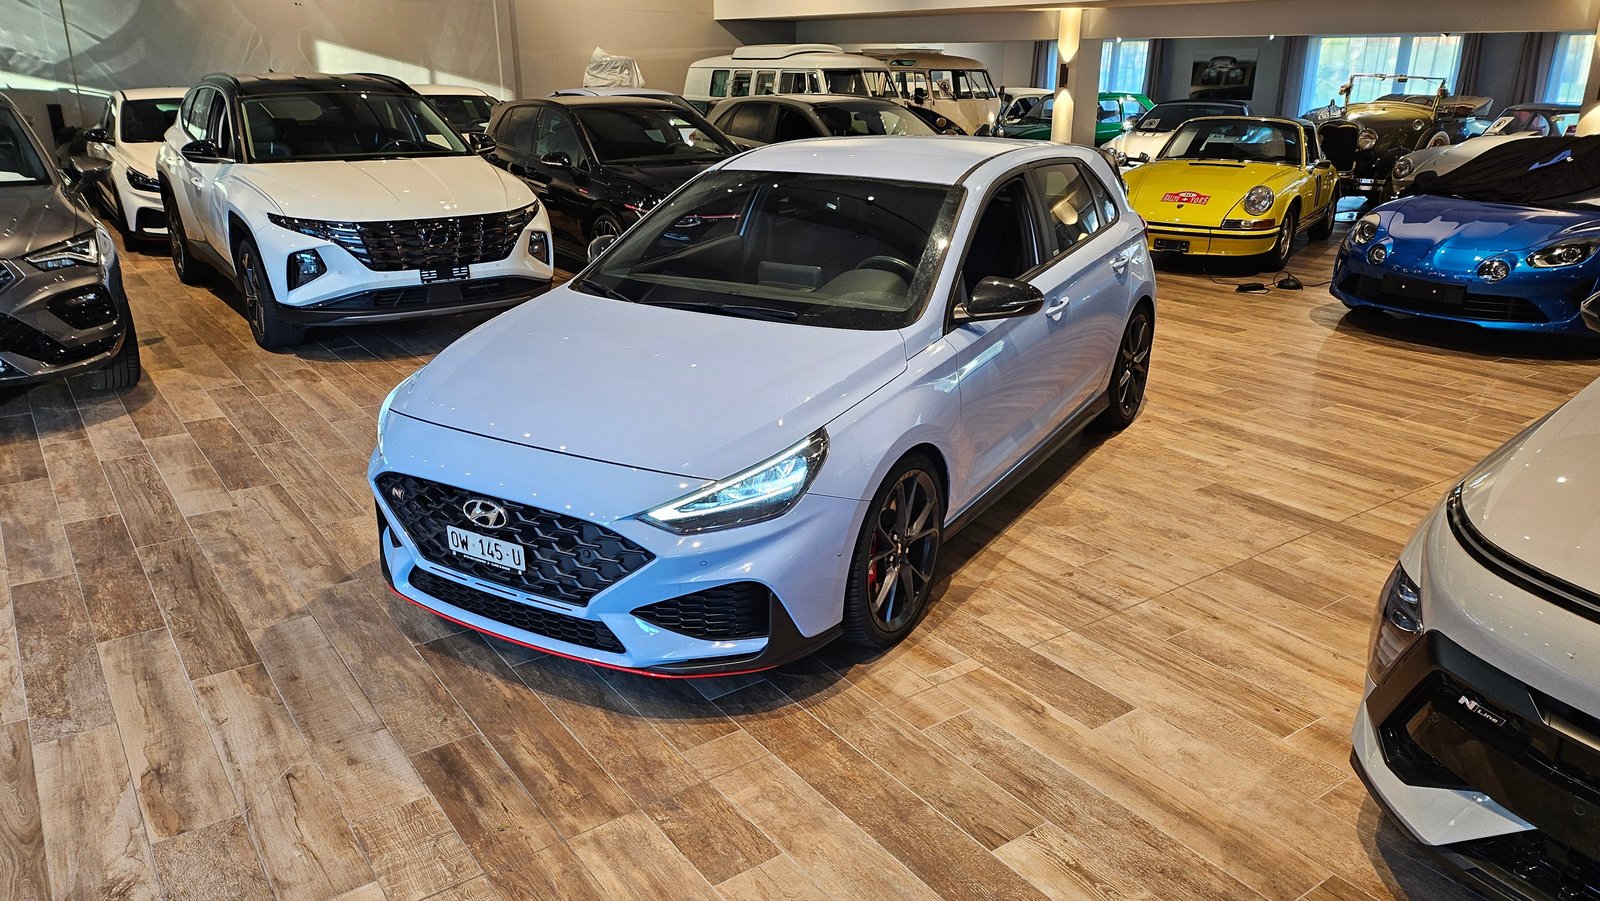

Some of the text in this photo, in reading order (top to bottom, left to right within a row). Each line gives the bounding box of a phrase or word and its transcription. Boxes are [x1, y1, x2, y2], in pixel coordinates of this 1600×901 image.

[479, 539, 503, 560] 145
[512, 548, 521, 566] U
[1477, 709, 1498, 724] Line
